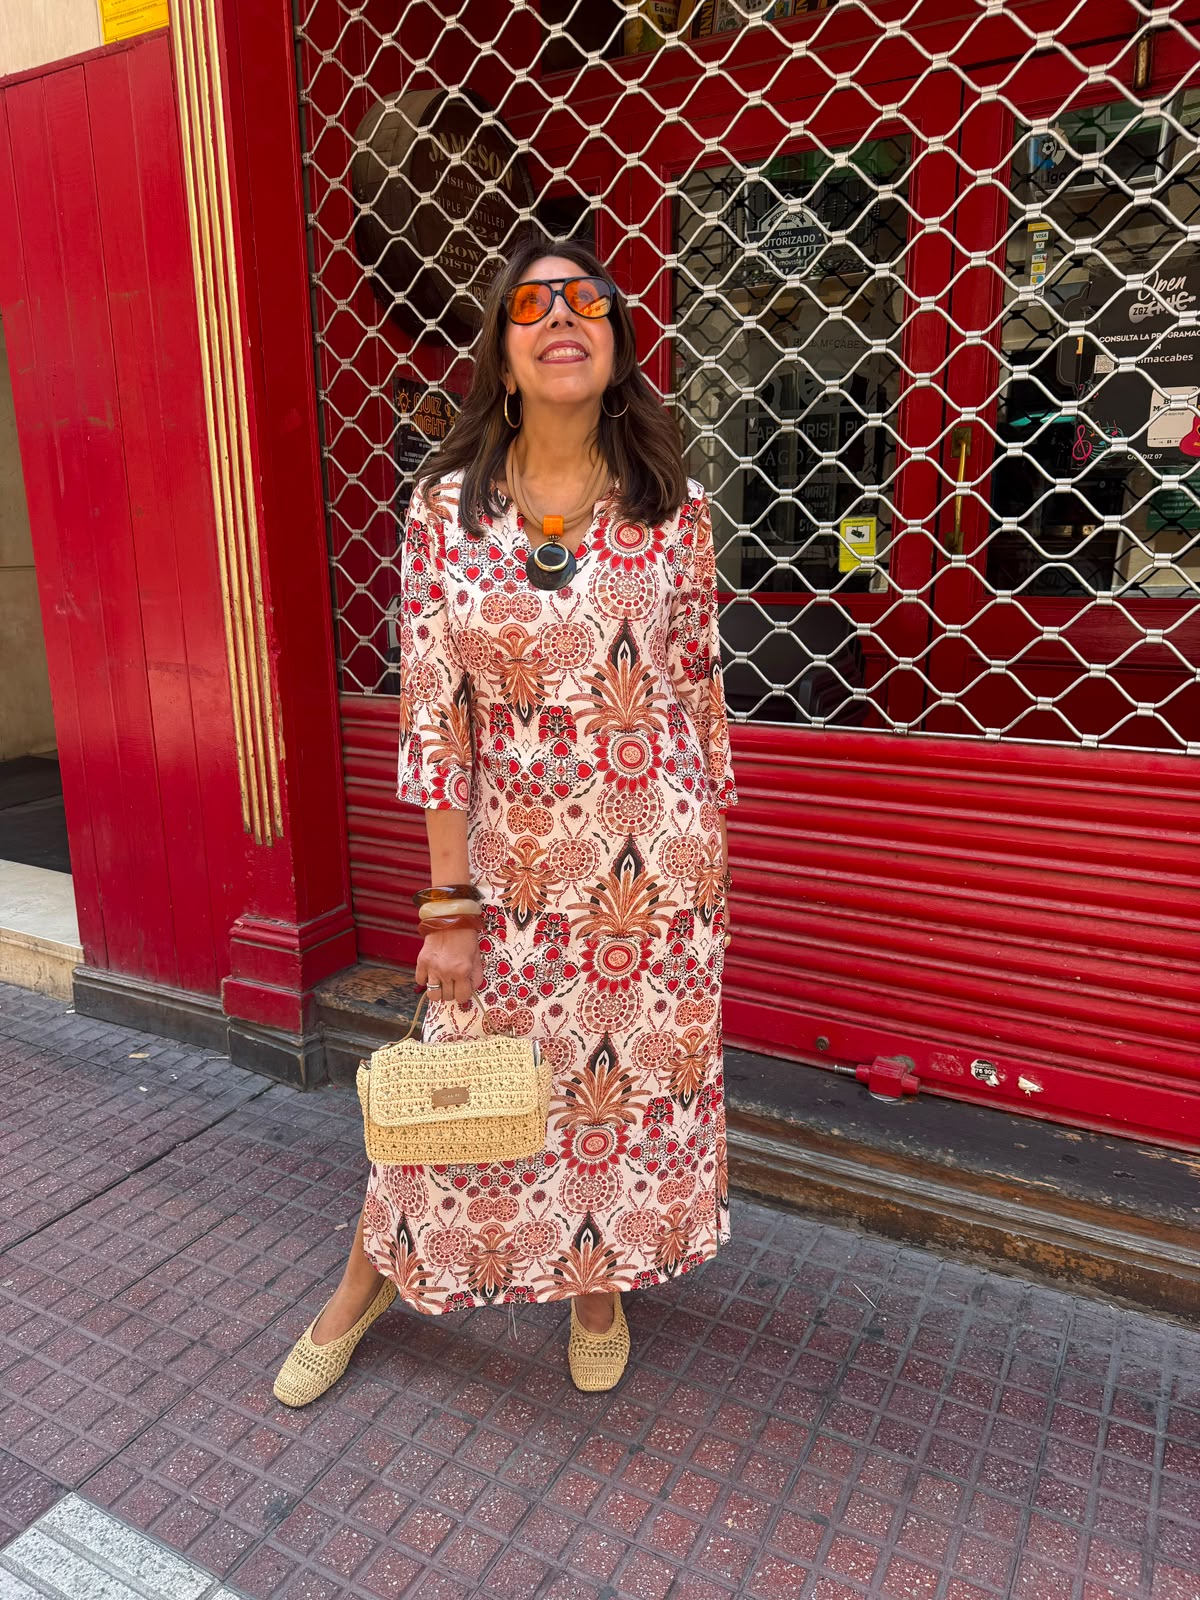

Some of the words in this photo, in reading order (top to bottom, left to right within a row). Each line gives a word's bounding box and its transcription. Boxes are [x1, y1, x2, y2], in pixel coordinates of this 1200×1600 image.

[465, 206, 505, 229] DSTILLED
[1133, 307, 1149, 316] ZGZ
[1099, 335, 1138, 343] CONSULTA
[1151, 330, 1200, 340] PRGRAMAC
[413, 392, 441, 416] QUIZ
[411, 413, 446, 438] NIGHT
